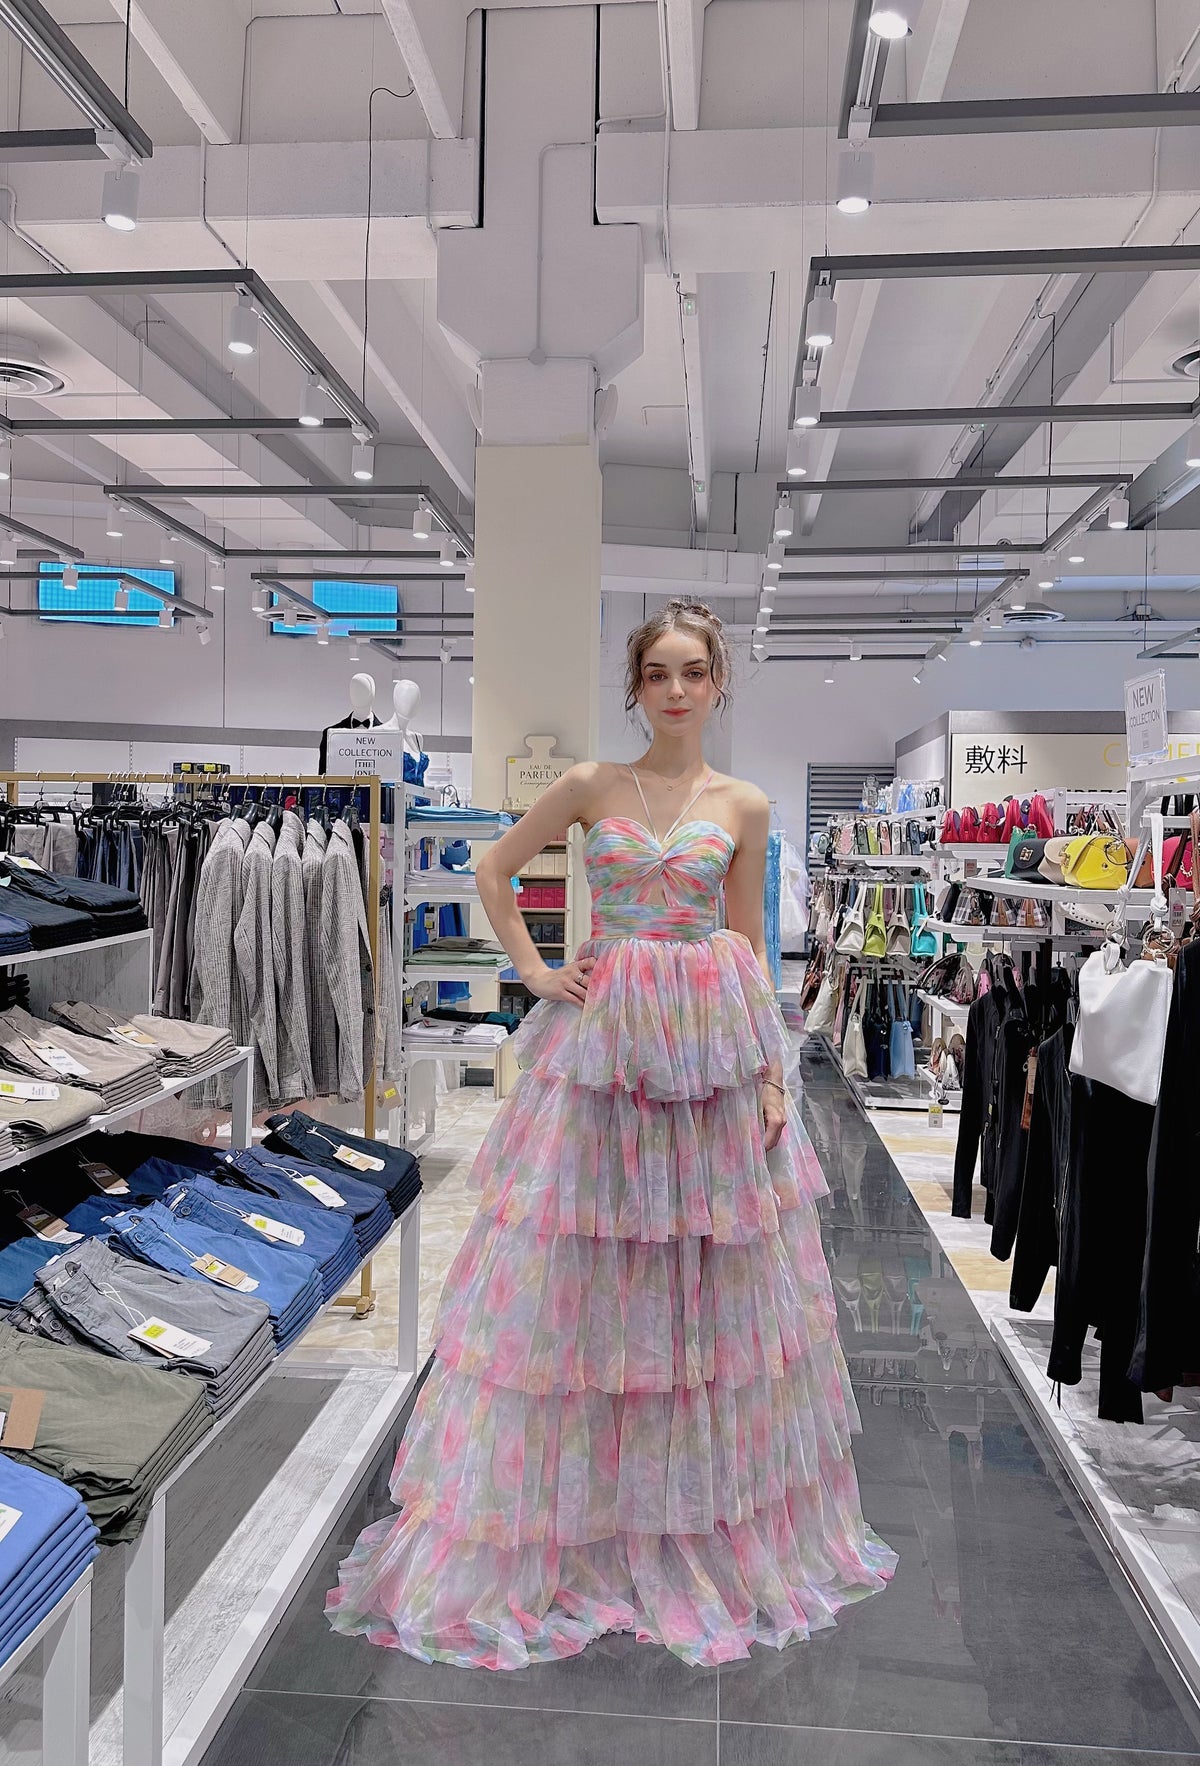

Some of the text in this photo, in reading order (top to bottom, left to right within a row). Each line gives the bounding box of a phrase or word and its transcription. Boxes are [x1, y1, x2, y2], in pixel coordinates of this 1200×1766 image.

[1132, 683, 1155, 709] NEW
[1130, 708, 1161, 728] COLLECTION
[355, 737, 376, 745] NEW
[338, 748, 393, 757] COLLECTION
[965, 745, 1028, 774] 敷料
[519, 771, 562, 779] PARFUM
